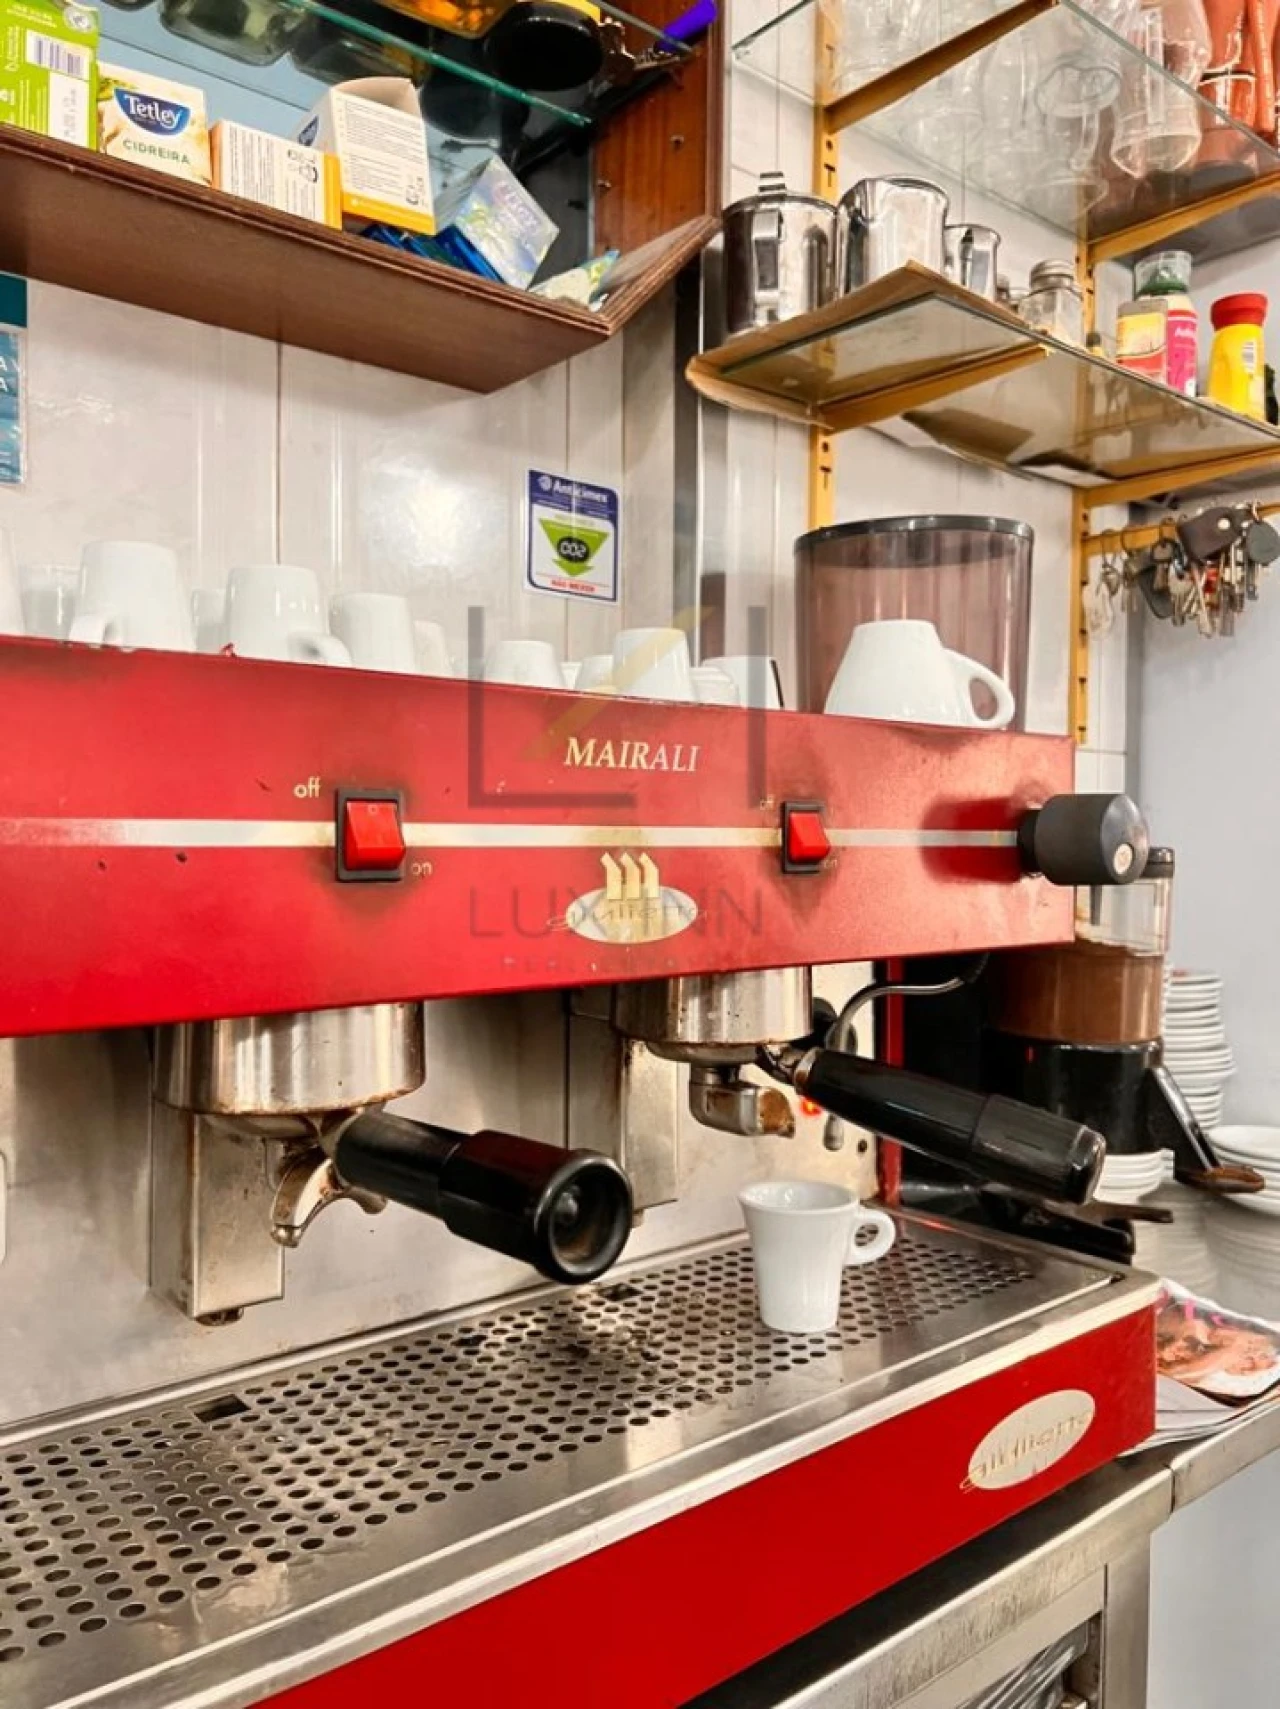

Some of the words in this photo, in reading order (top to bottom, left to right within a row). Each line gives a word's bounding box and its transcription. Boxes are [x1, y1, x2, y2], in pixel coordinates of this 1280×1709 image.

[124, 95, 183, 128] Tetley
[123, 139, 190, 164] CIDREIRA
[563, 736, 699, 772] MAIRALI
[293, 776, 321, 798] off
[411, 861, 432, 875] on
